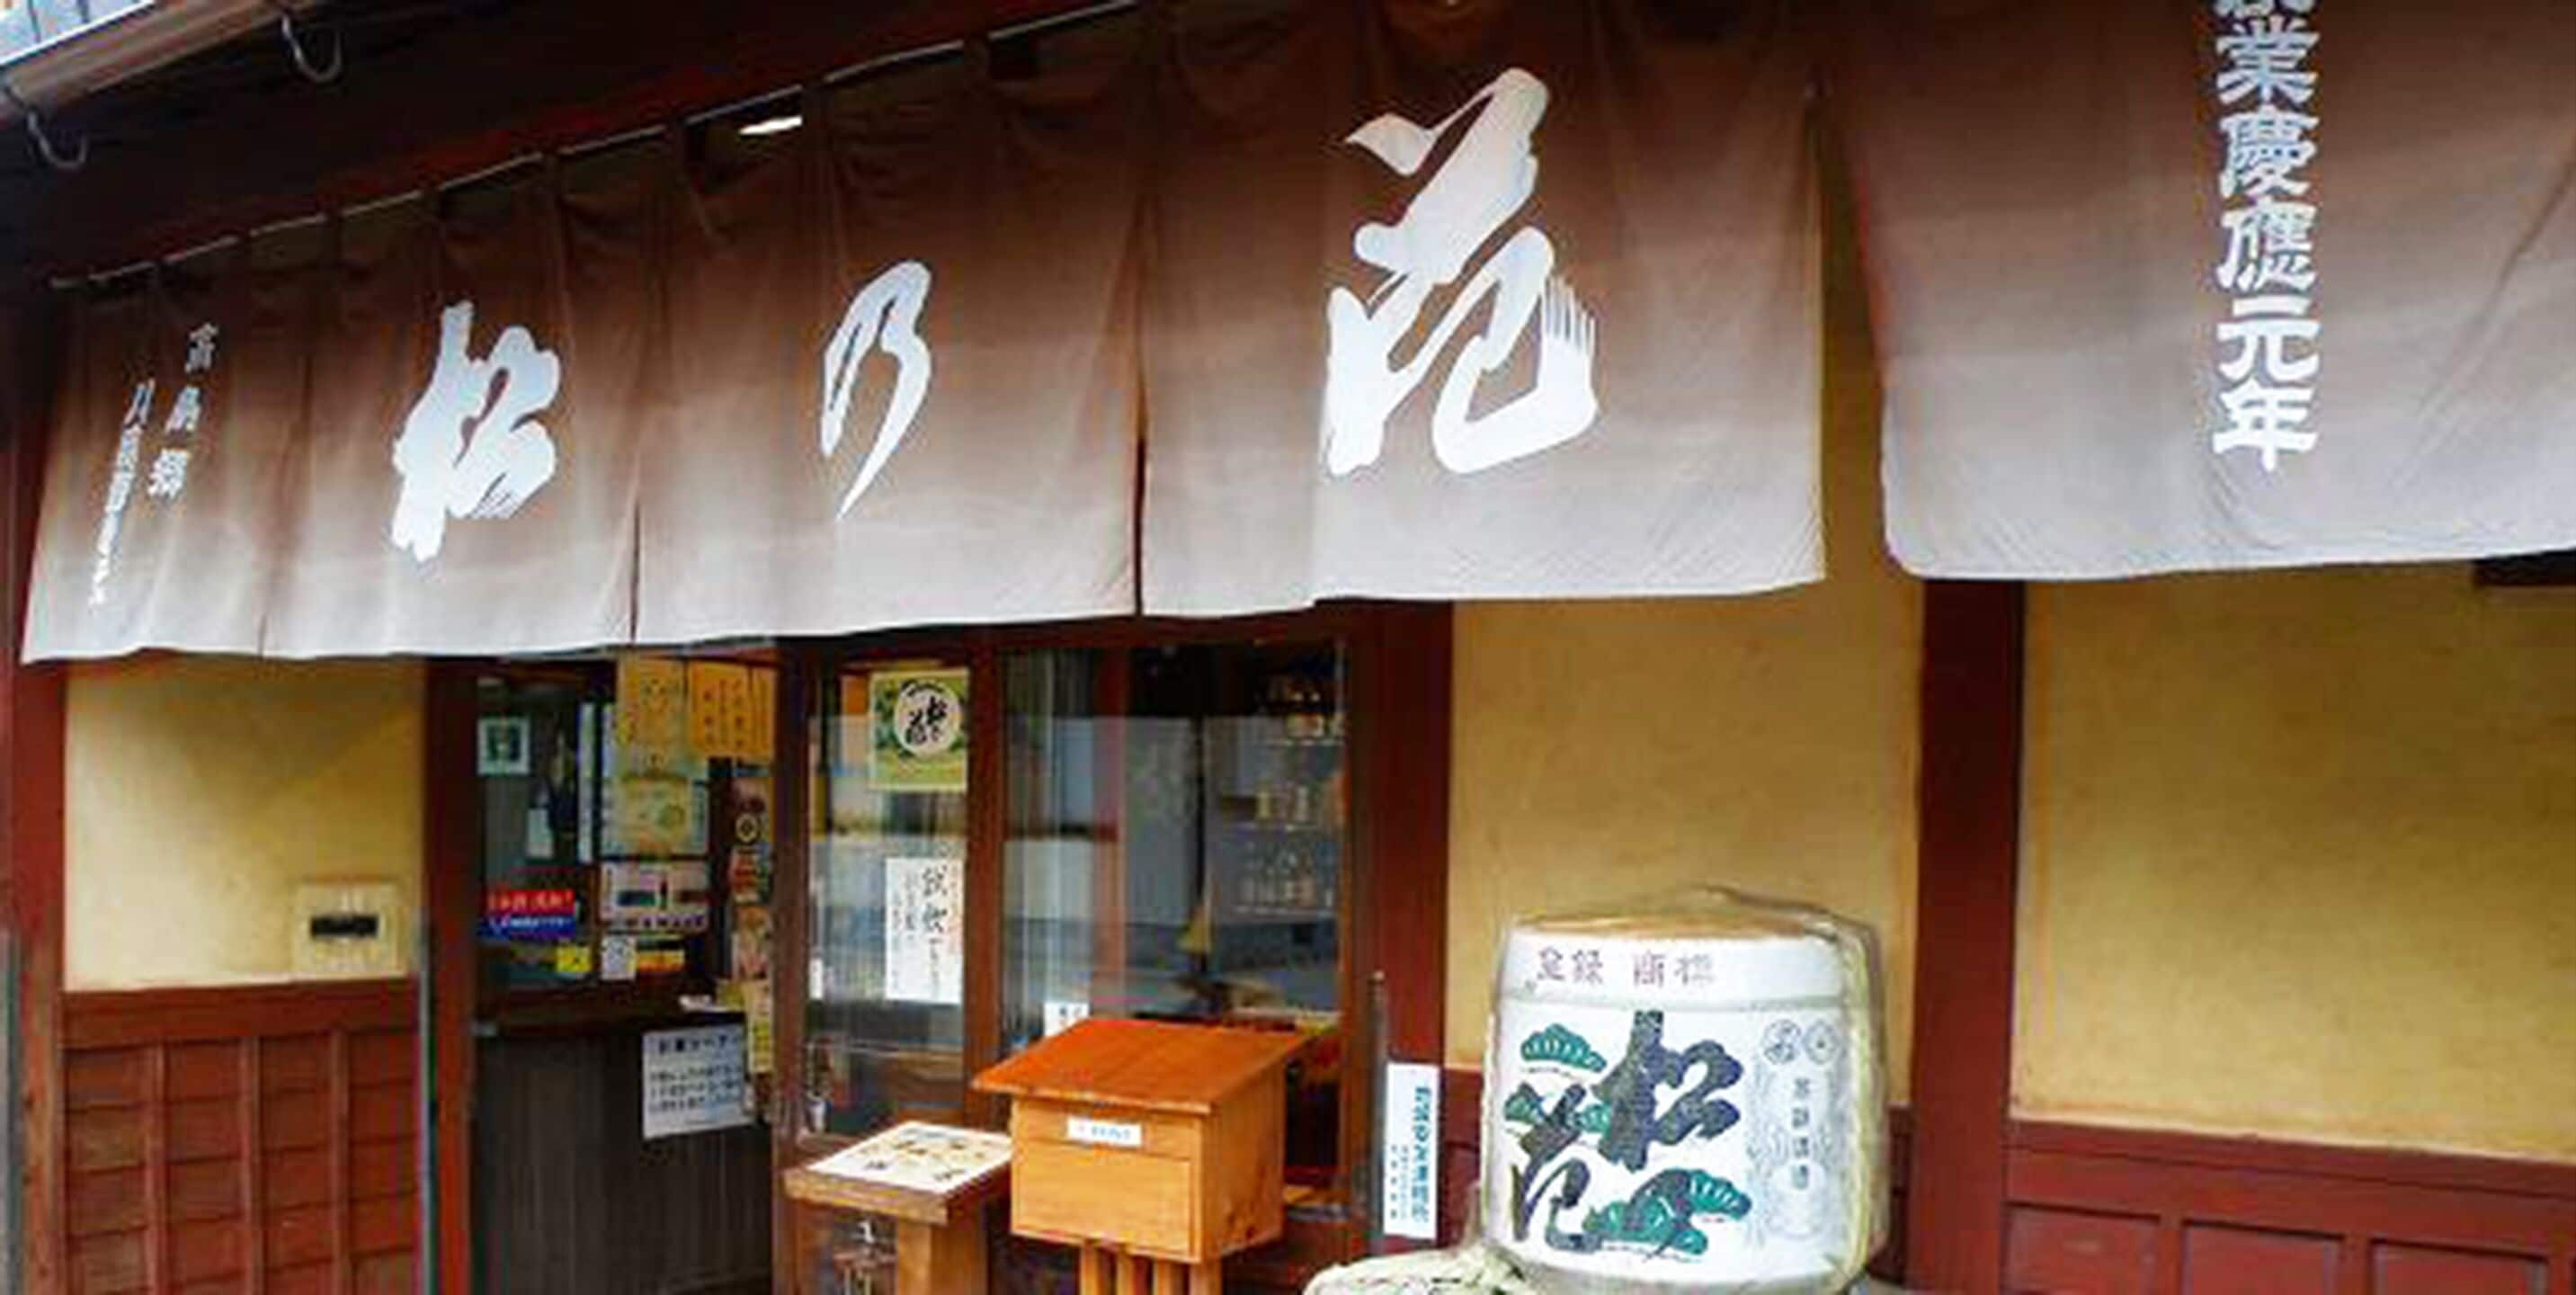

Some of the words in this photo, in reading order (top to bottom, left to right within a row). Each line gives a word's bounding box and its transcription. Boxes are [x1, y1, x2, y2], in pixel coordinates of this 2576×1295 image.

[2212, 0, 2322, 473] 業慶應元年
